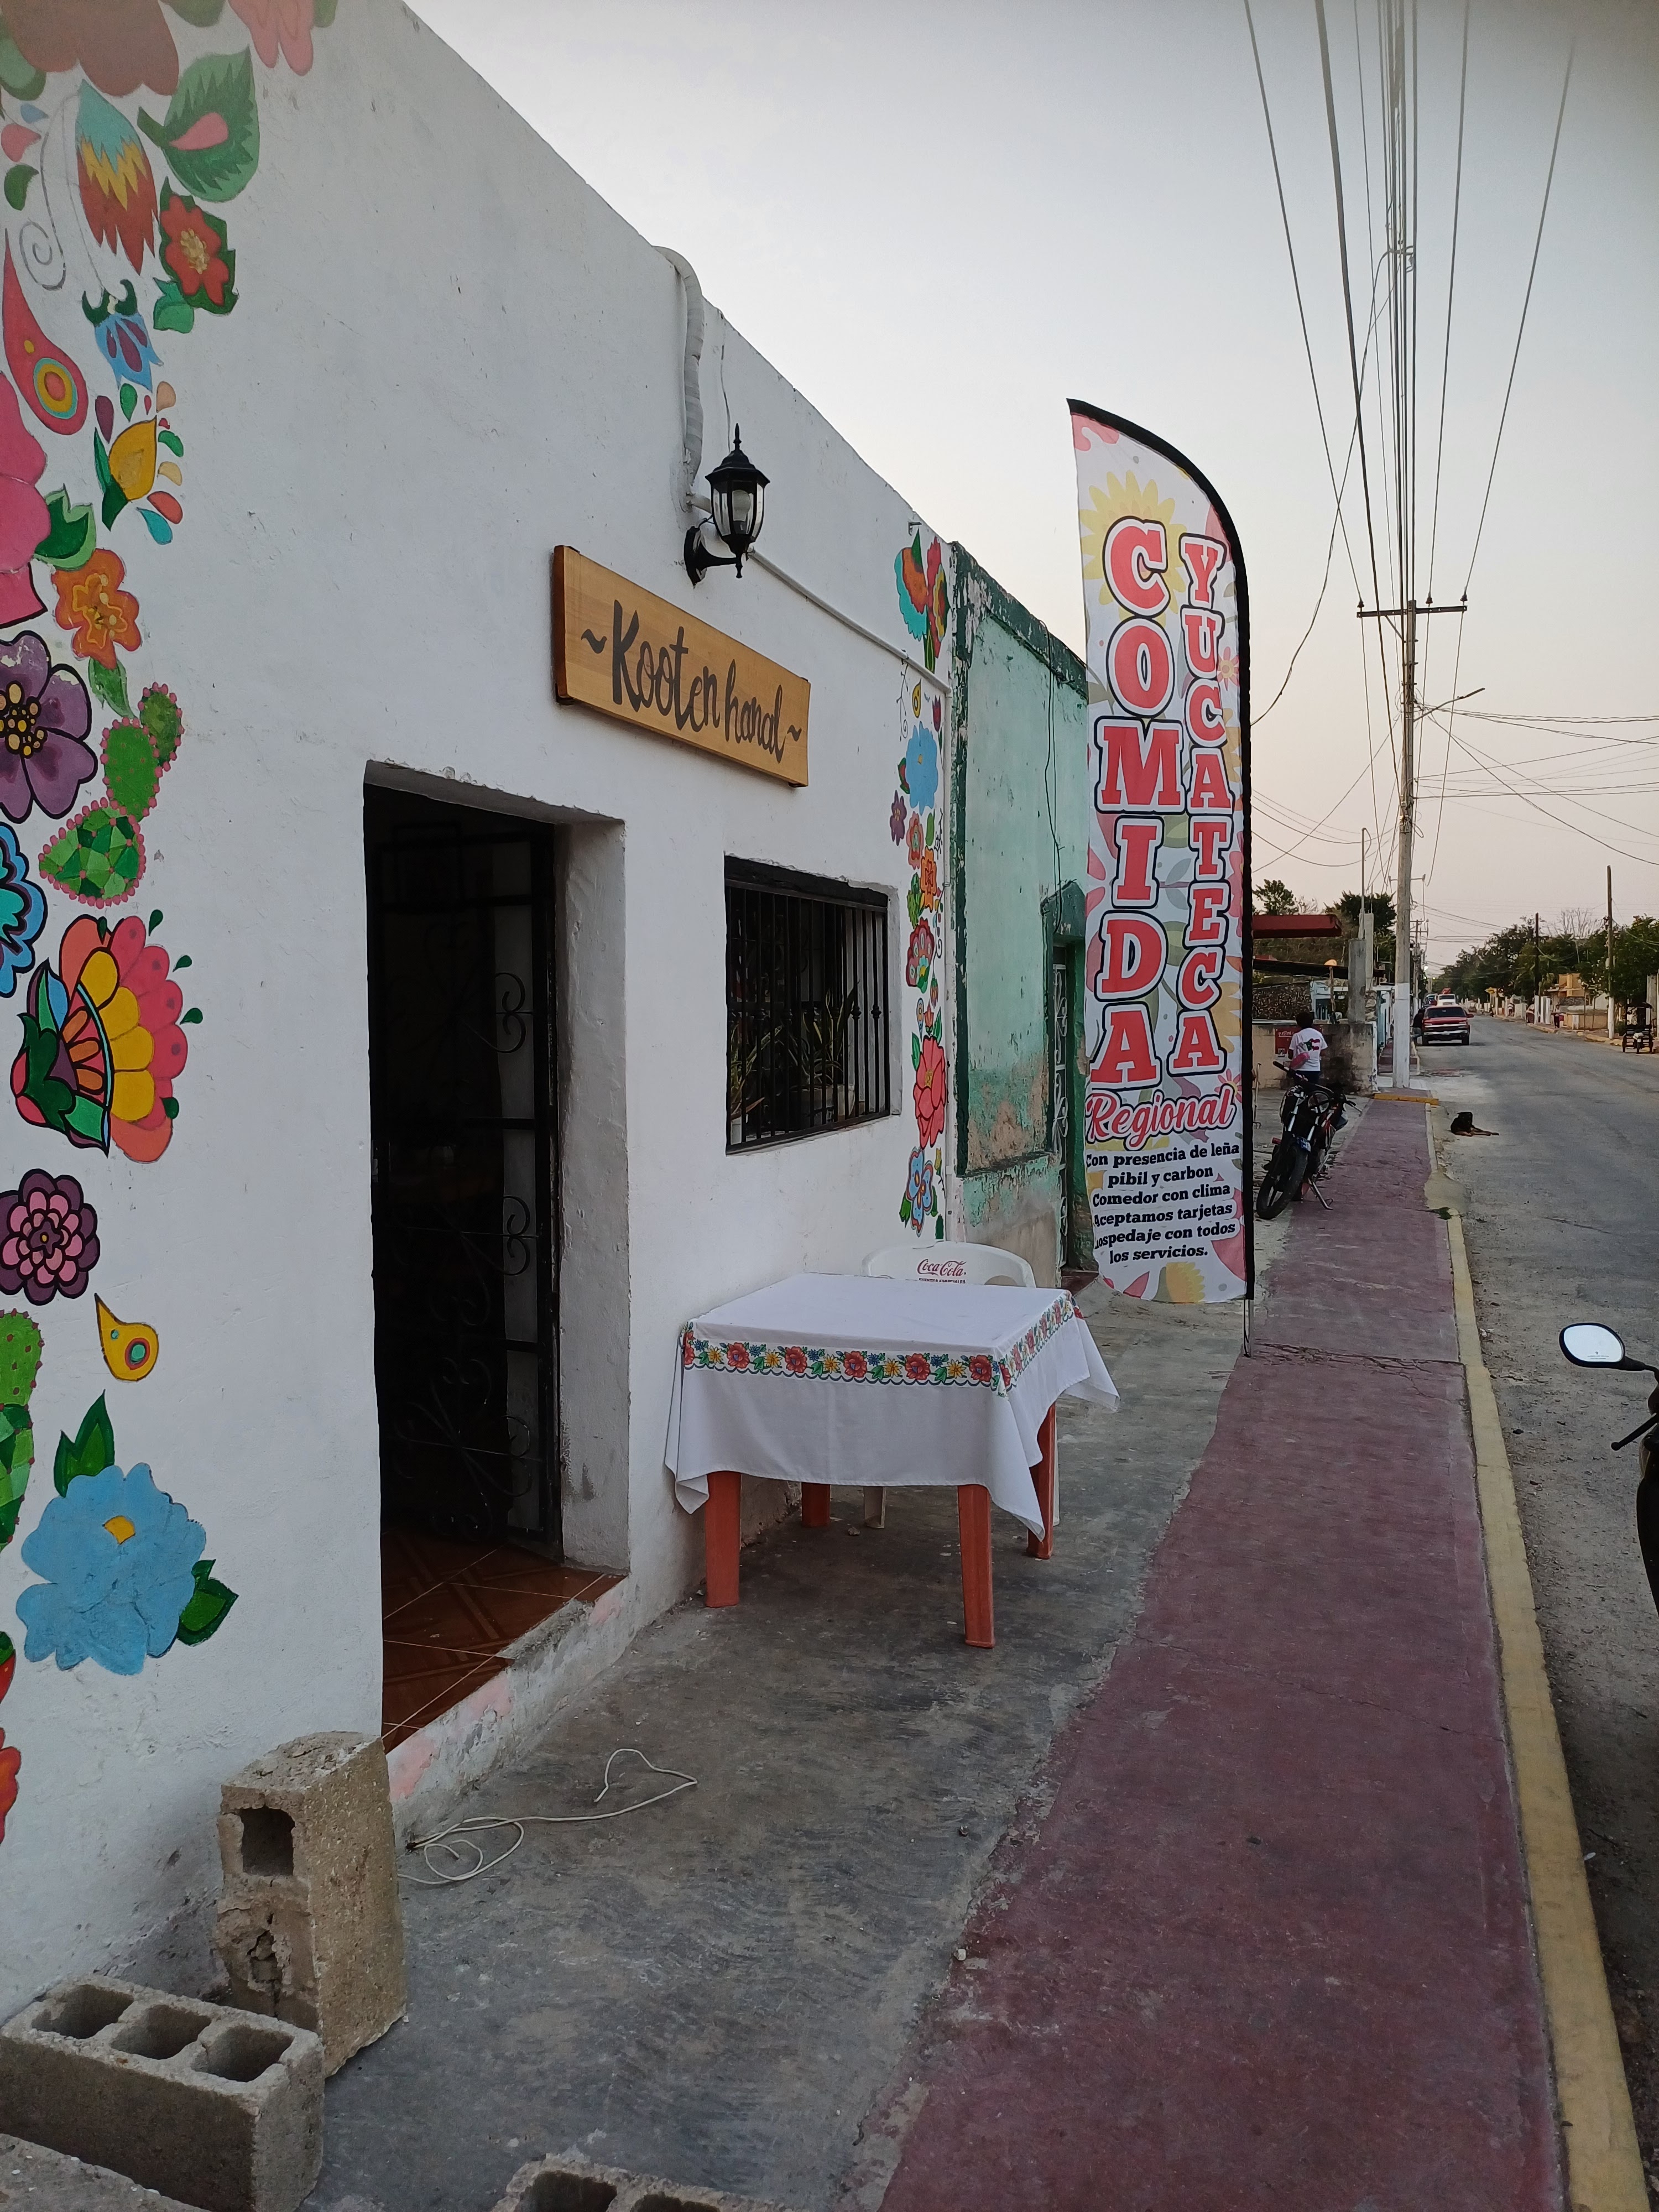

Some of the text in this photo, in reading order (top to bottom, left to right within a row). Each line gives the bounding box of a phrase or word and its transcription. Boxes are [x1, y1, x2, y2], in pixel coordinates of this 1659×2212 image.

[612, 599, 720, 732] Kooten
[1091, 519, 1182, 1086] COMIDA
[1169, 536, 1233, 1073] YUCATECA
[1085, 1086, 1235, 1148] Regional
[1086, 1142, 1240, 1168] Con presencia de leña
[1107, 1165, 1214, 1188] pibil y carbon
[1092, 1183, 1230, 1208] Comedor con clima
[1093, 1203, 1233, 1227] Aceptamos tarjetas
[1164, 1228, 1193, 1240] con
[1197, 1222, 1236, 1237] todos
[1109, 1244, 1208, 1265] los servicios.
